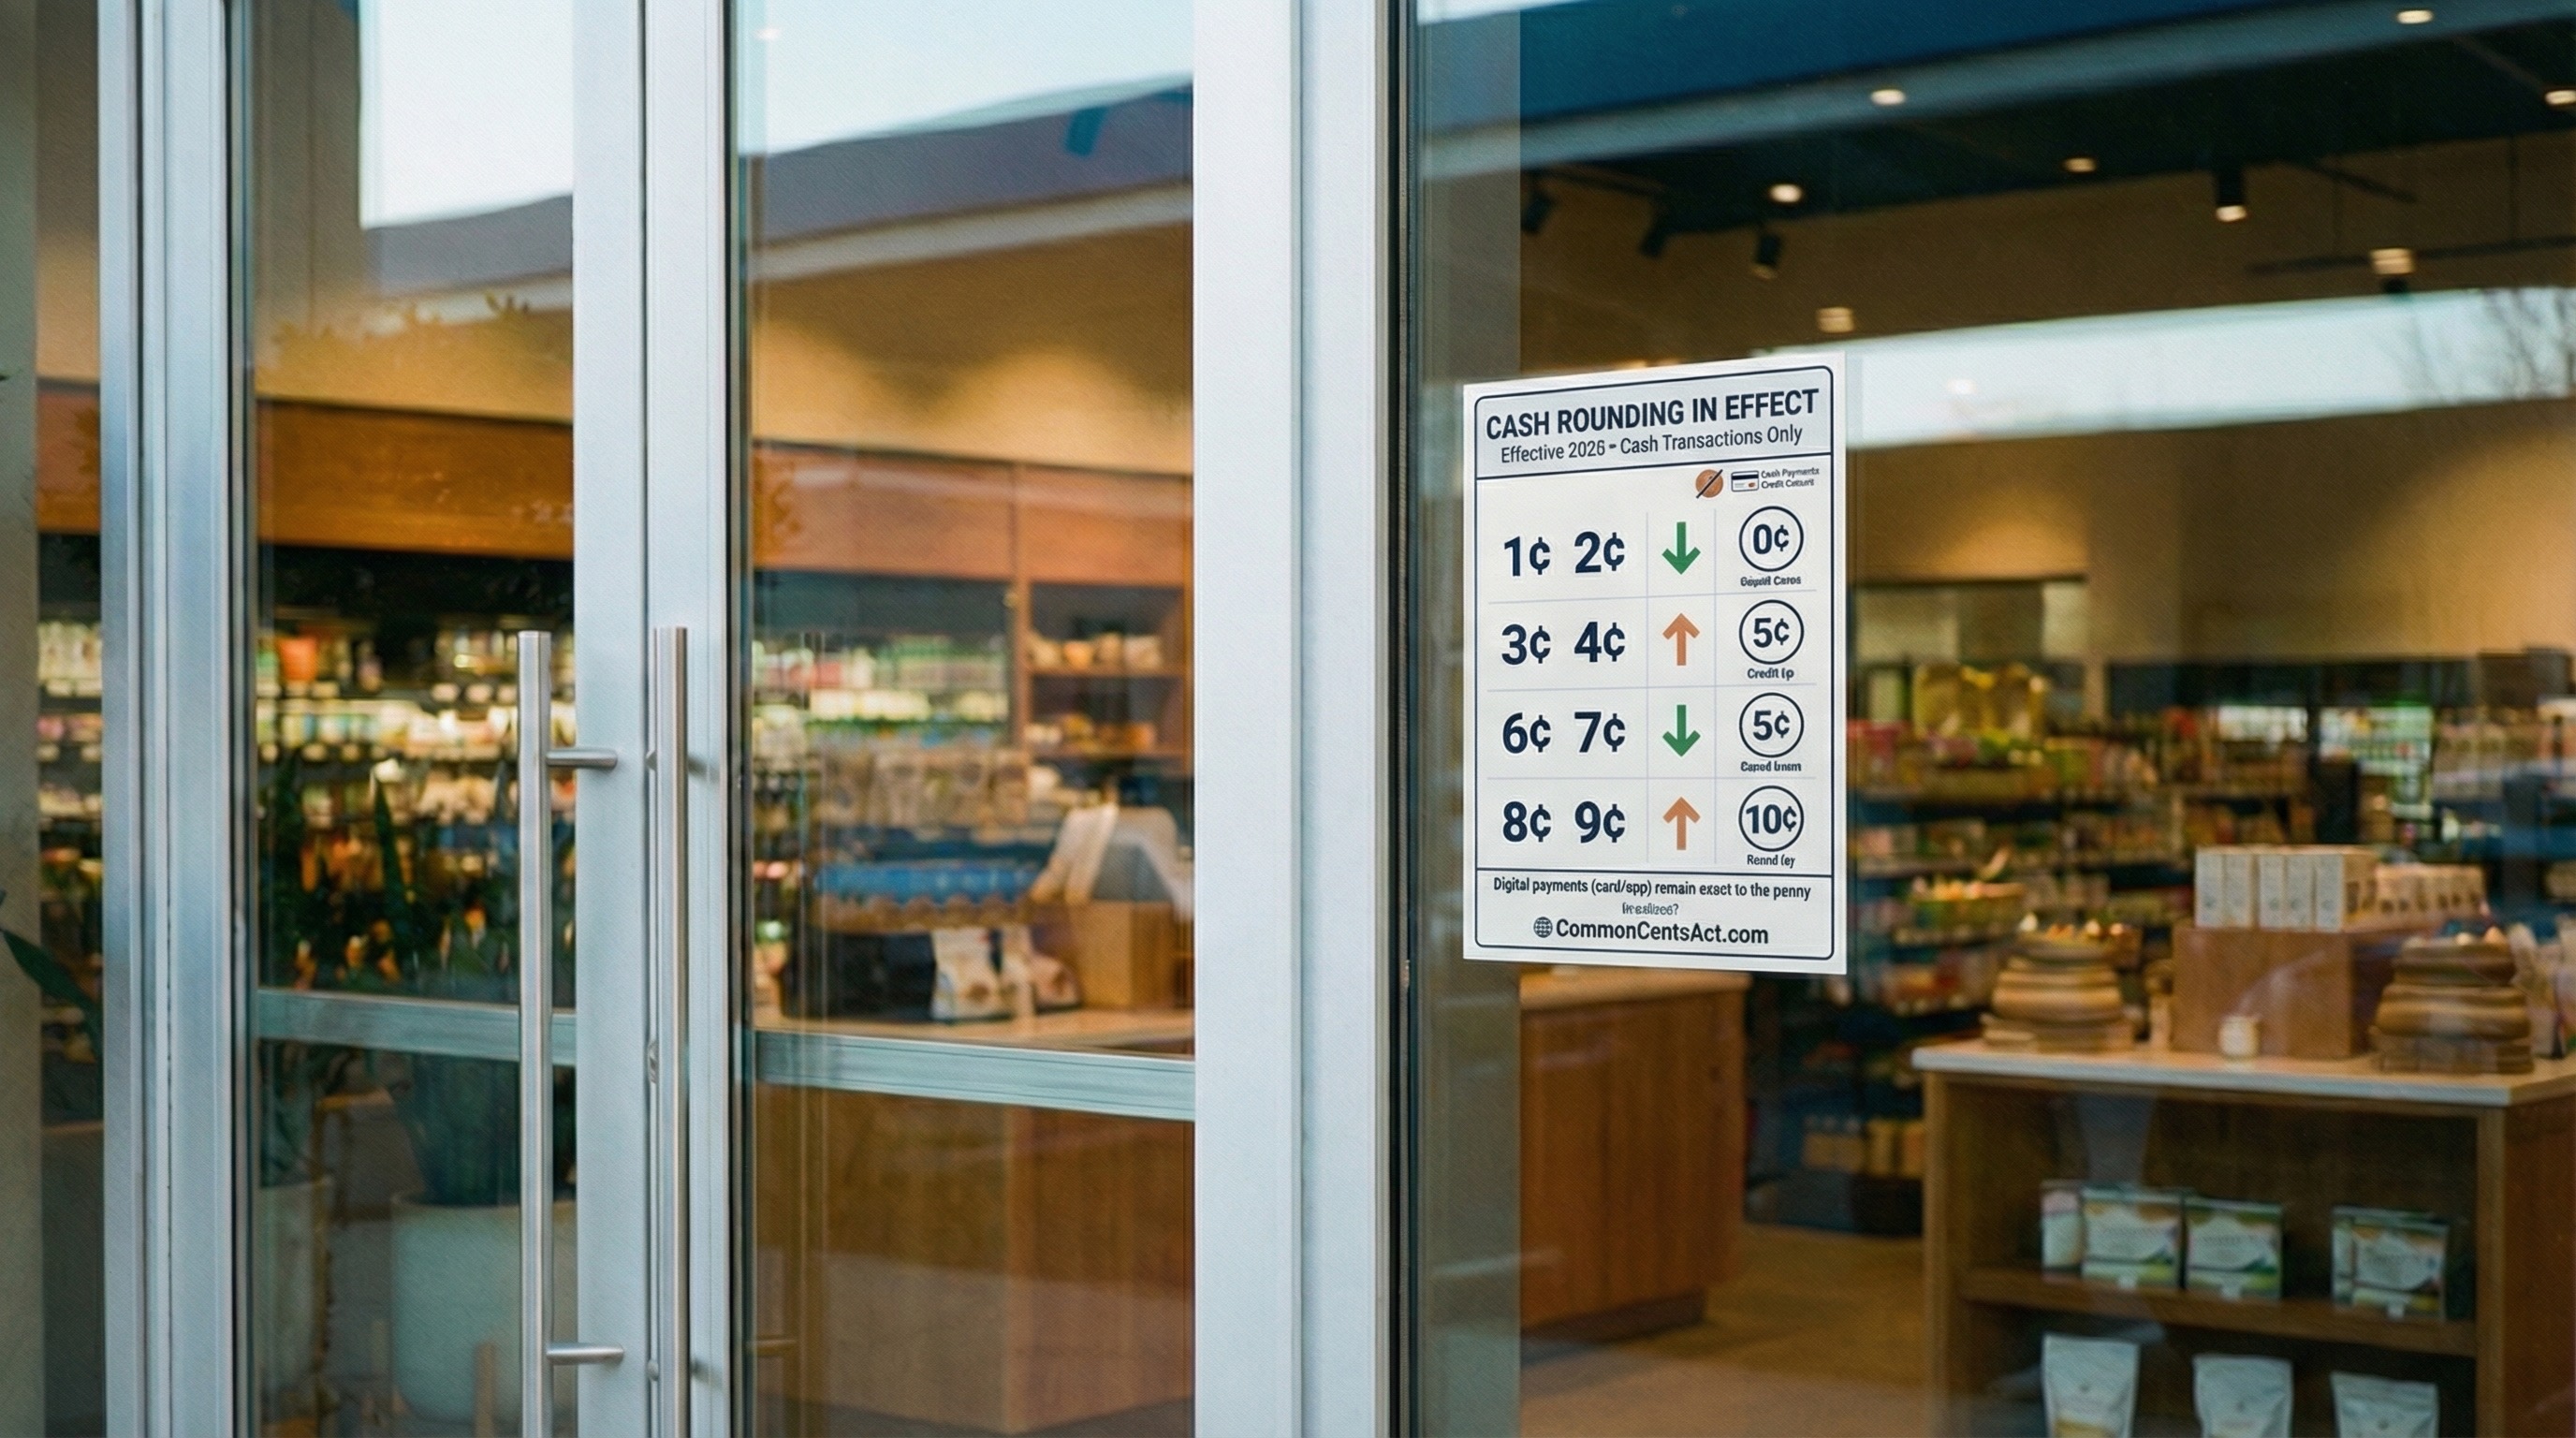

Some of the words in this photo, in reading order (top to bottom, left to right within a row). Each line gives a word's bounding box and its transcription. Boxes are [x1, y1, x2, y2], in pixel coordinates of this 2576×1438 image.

[1486, 411, 1549, 440] CASH
[1558, 400, 1684, 433] ROUNDING
[1692, 397, 1717, 422] IN
[1725, 389, 1819, 420] EFFECT
[1501, 445, 1564, 463] Effective
[1569, 440, 1605, 458] 2026
[1620, 434, 1658, 454] Cash
[1662, 430, 1763, 450] Transactions
[1767, 425, 1803, 446] Only
[1504, 536, 1550, 577] 1¢
[1574, 532, 1624, 573] 2¢
[1753, 524, 1789, 554] 0¢
[1501, 624, 1550, 665] 3¢
[1574, 622, 1625, 663] 4¢
[1753, 618, 1789, 648] 5¢
[1503, 712, 1551, 754] 6¢
[1574, 712, 1625, 753] 7¢
[1753, 710, 1790, 741] 5¢
[1503, 801, 1551, 843] 8¢
[1575, 801, 1625, 844] 9¢
[1745, 803, 1798, 835] 10¢
[1494, 876, 1530, 893] Digital
[1532, 880, 1588, 895] payments
[1655, 882, 1696, 894] remain
[1734, 884, 1747, 896] to
[1750, 883, 1770, 897] the
[1774, 887, 1811, 902] penny
[1557, 918, 1768, 944] CommonCentsAct.com
